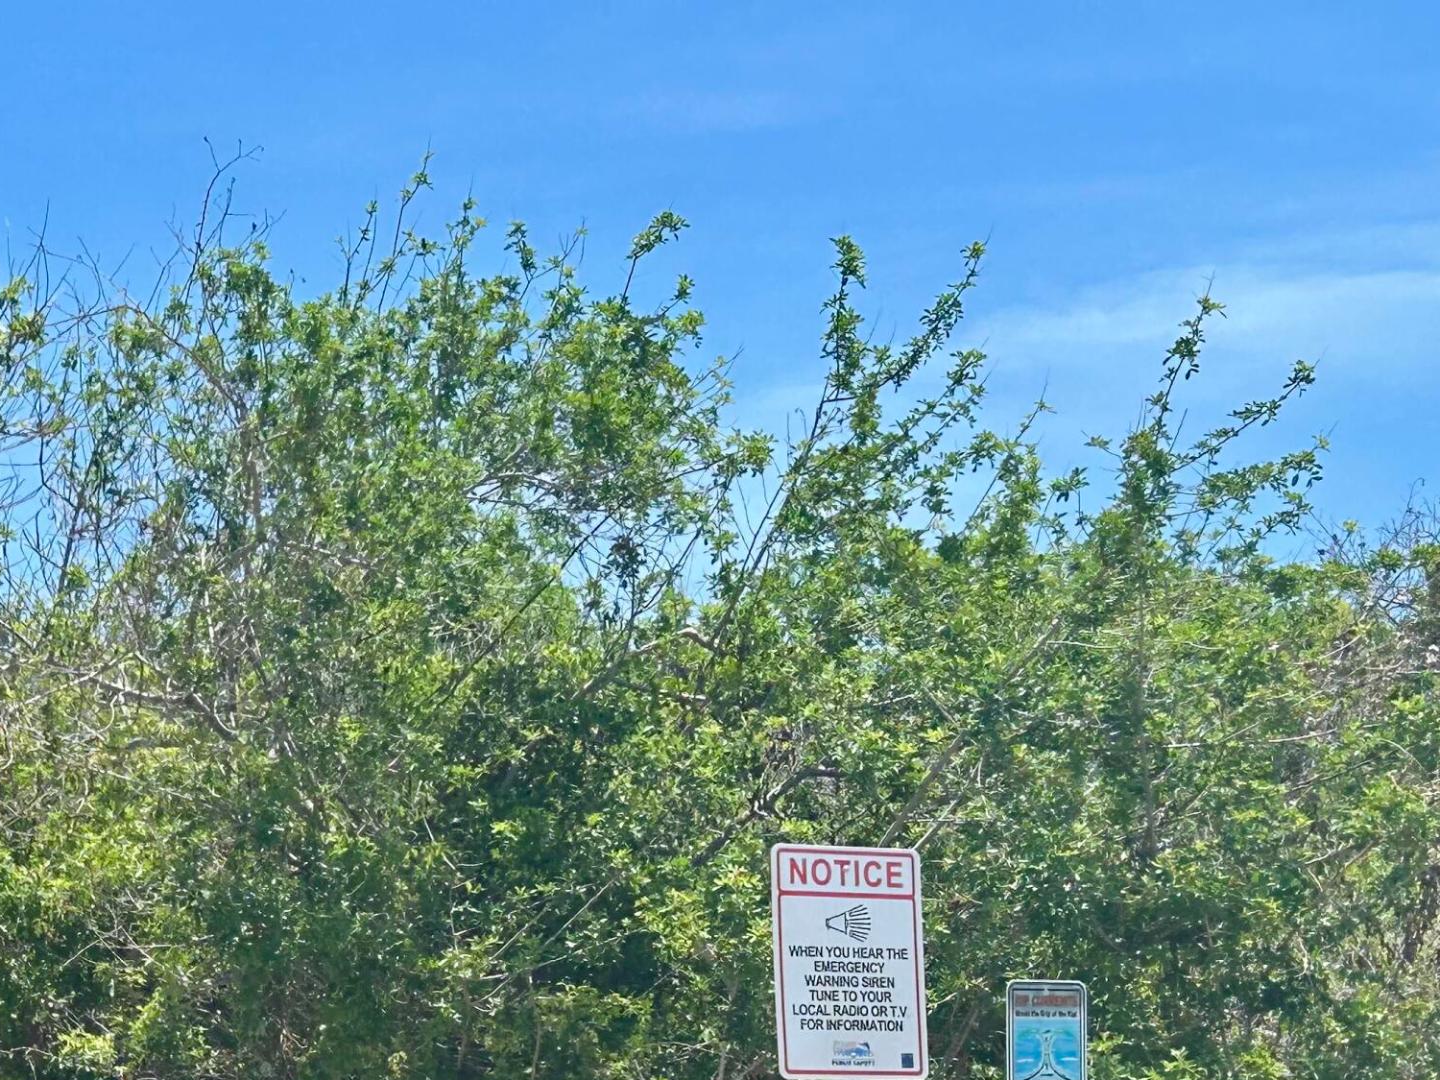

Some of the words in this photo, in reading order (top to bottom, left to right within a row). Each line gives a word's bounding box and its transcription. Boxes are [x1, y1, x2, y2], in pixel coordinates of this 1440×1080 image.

[789, 858, 904, 888] NOTICE
[789, 945, 823, 958] WHEN
[825, 946, 850, 958] YOU
[853, 947, 884, 959] HEAR
[887, 948, 909, 960] THE
[814, 961, 885, 974] EMERGENCY
[804, 975, 859, 988] WARNING
[861, 976, 895, 988] SIREN
[809, 990, 839, 1001] TUNE
[843, 991, 857, 1002] TO
[860, 991, 892, 1003] YOUR
[793, 1004, 831, 1016] LOCAL
[833, 1005, 869, 1017] RADIO
[871, 1005, 888, 1017] OR
[800, 1018, 824, 1031] FOR
[826, 1019, 904, 1032] INFORMATION
